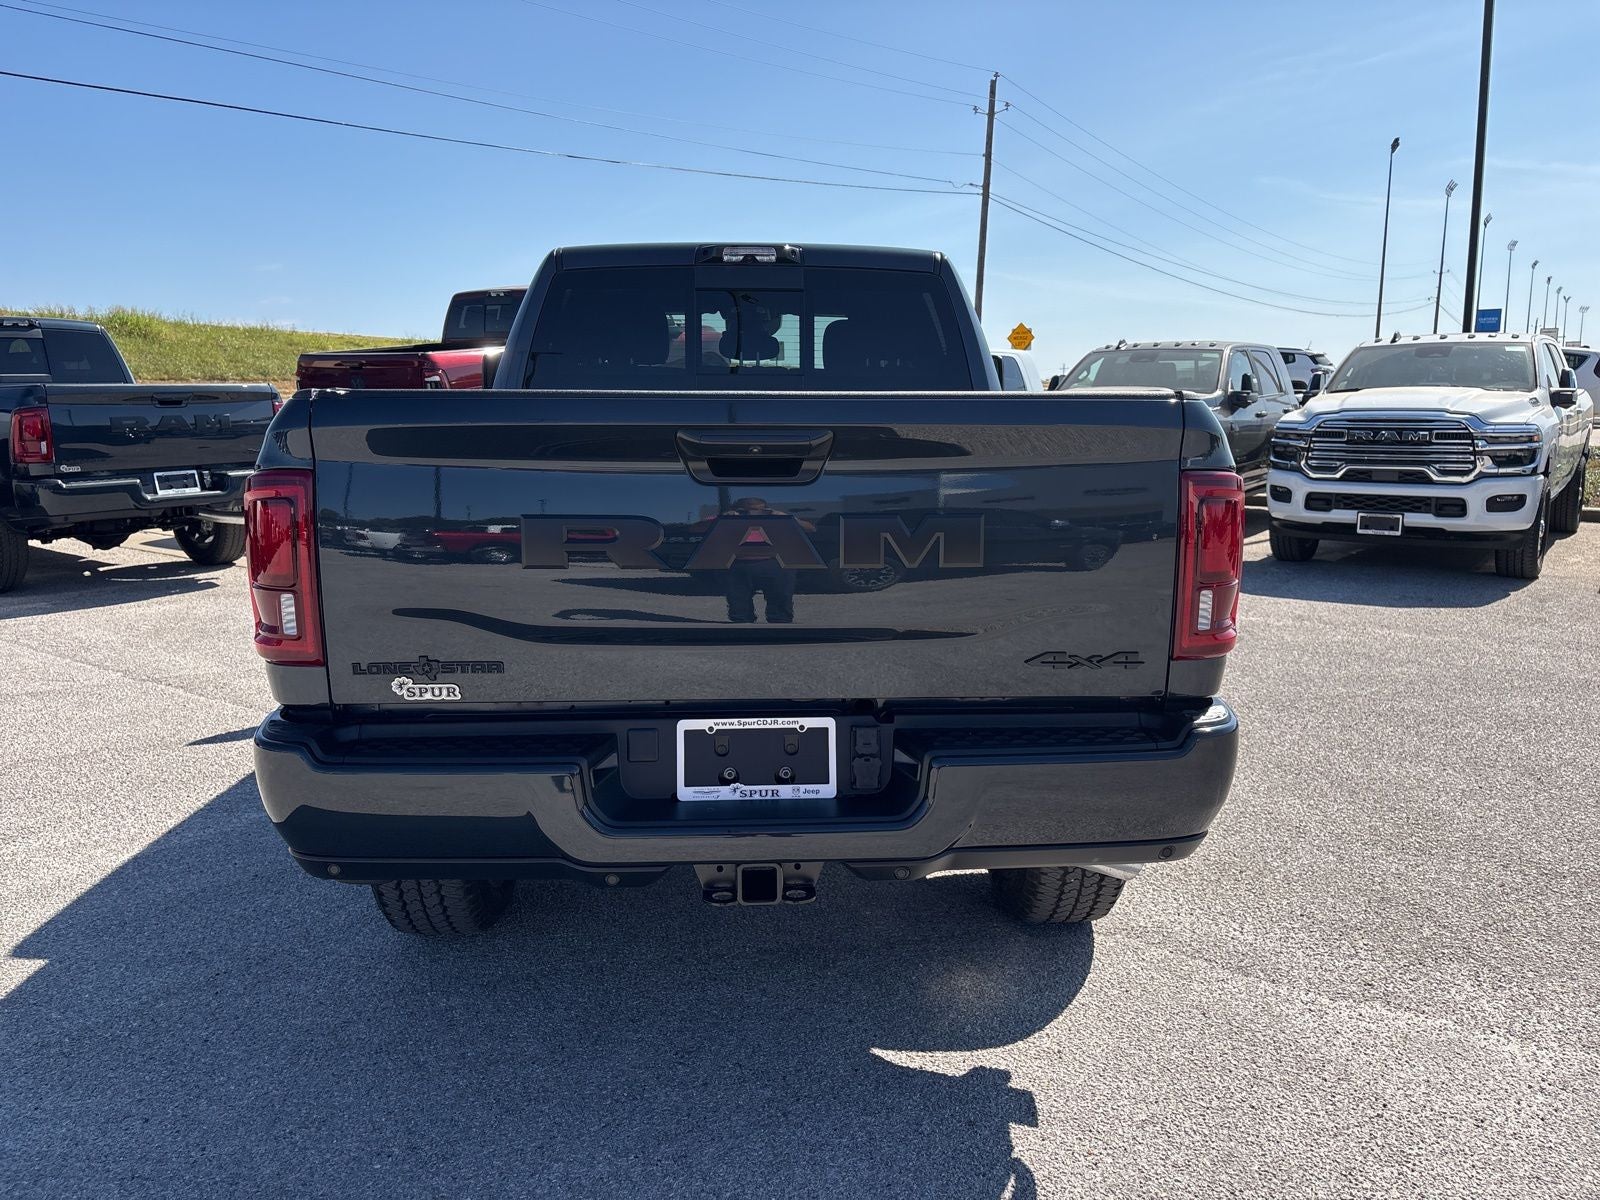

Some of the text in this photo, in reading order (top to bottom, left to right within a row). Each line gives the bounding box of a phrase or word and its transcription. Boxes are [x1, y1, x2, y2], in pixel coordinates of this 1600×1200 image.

[109, 414, 231, 433] RAM
[1347, 430, 1430, 442] RAM
[520, 513, 985, 570] RAM
[352, 661, 505, 675] LONE STAR
[407, 687, 458, 698] SPUR
[713, 719, 800, 728] www.SpurCDJR.com
[739, 788, 781, 798] SPUR
